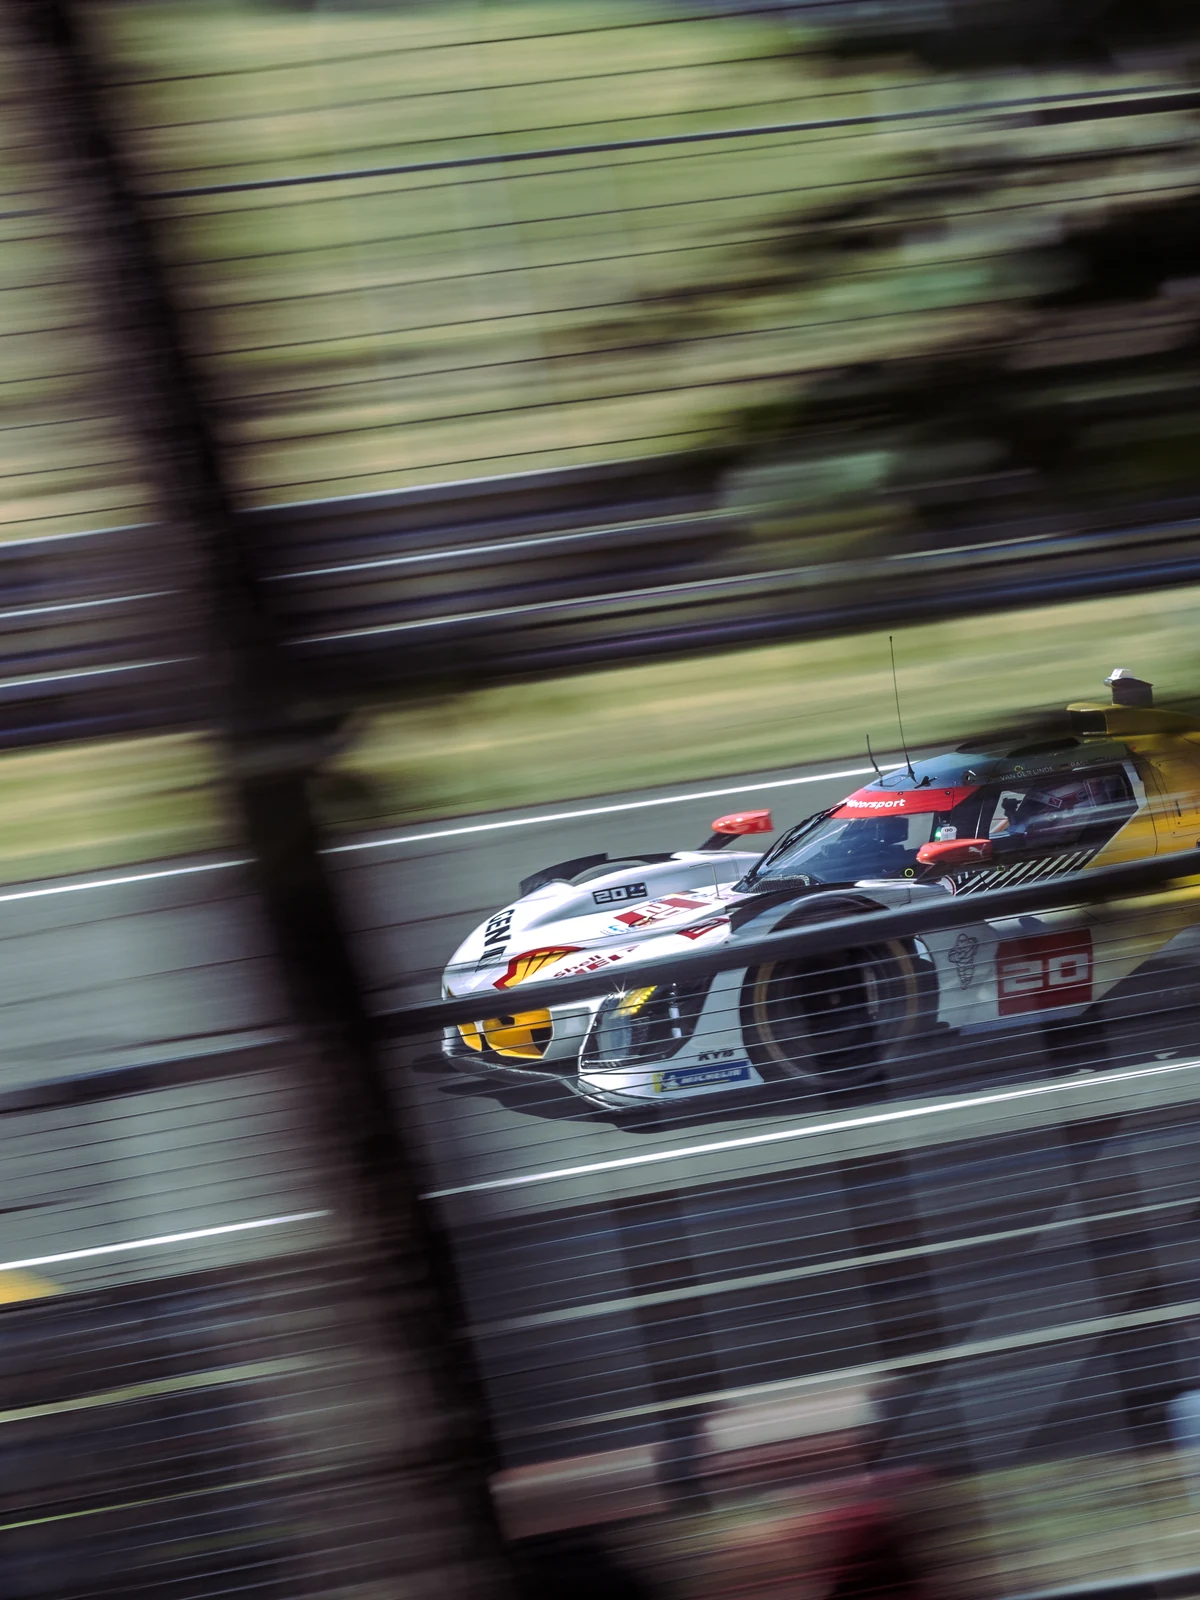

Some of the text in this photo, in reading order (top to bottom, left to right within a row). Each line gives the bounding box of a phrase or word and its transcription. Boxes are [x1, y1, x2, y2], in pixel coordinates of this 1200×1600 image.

[999, 766, 1056, 782] VAN DER LINDE
[594, 887, 629, 903] 20
[484, 908, 516, 947] GEN
[1002, 953, 1090, 994] 20
[681, 1068, 742, 1085] MICHELIN
